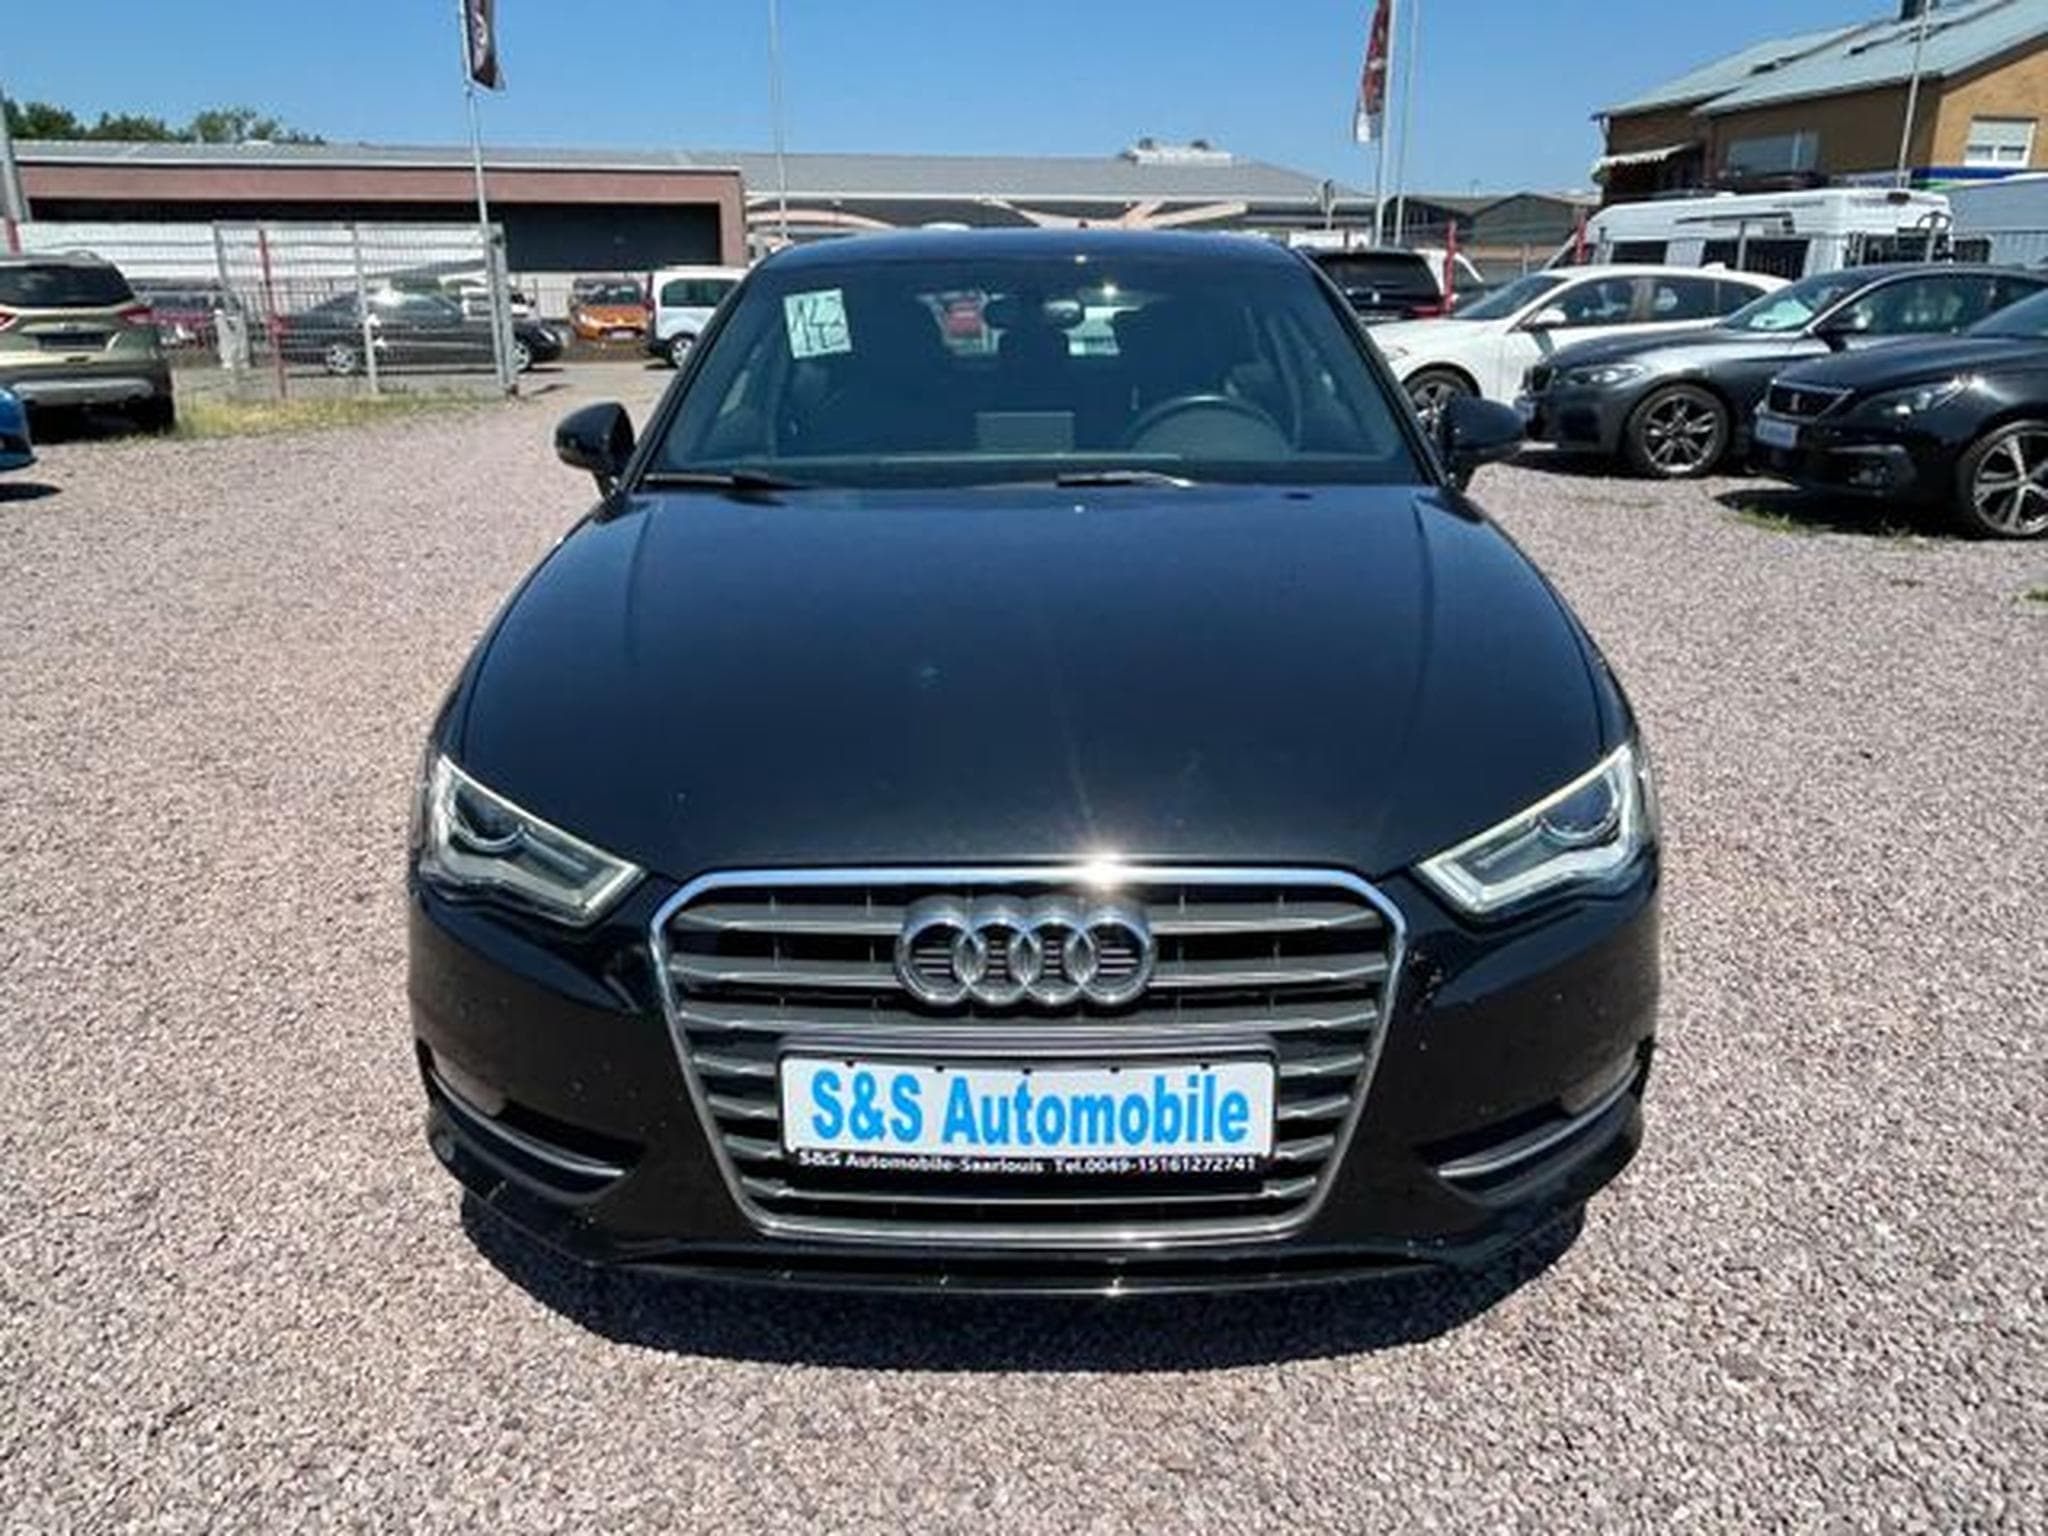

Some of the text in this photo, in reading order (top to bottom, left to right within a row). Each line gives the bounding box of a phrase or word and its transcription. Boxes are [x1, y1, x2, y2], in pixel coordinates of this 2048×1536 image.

[811, 1069, 1250, 1147] S&S Automobile
[799, 1150, 841, 1166] S&S
